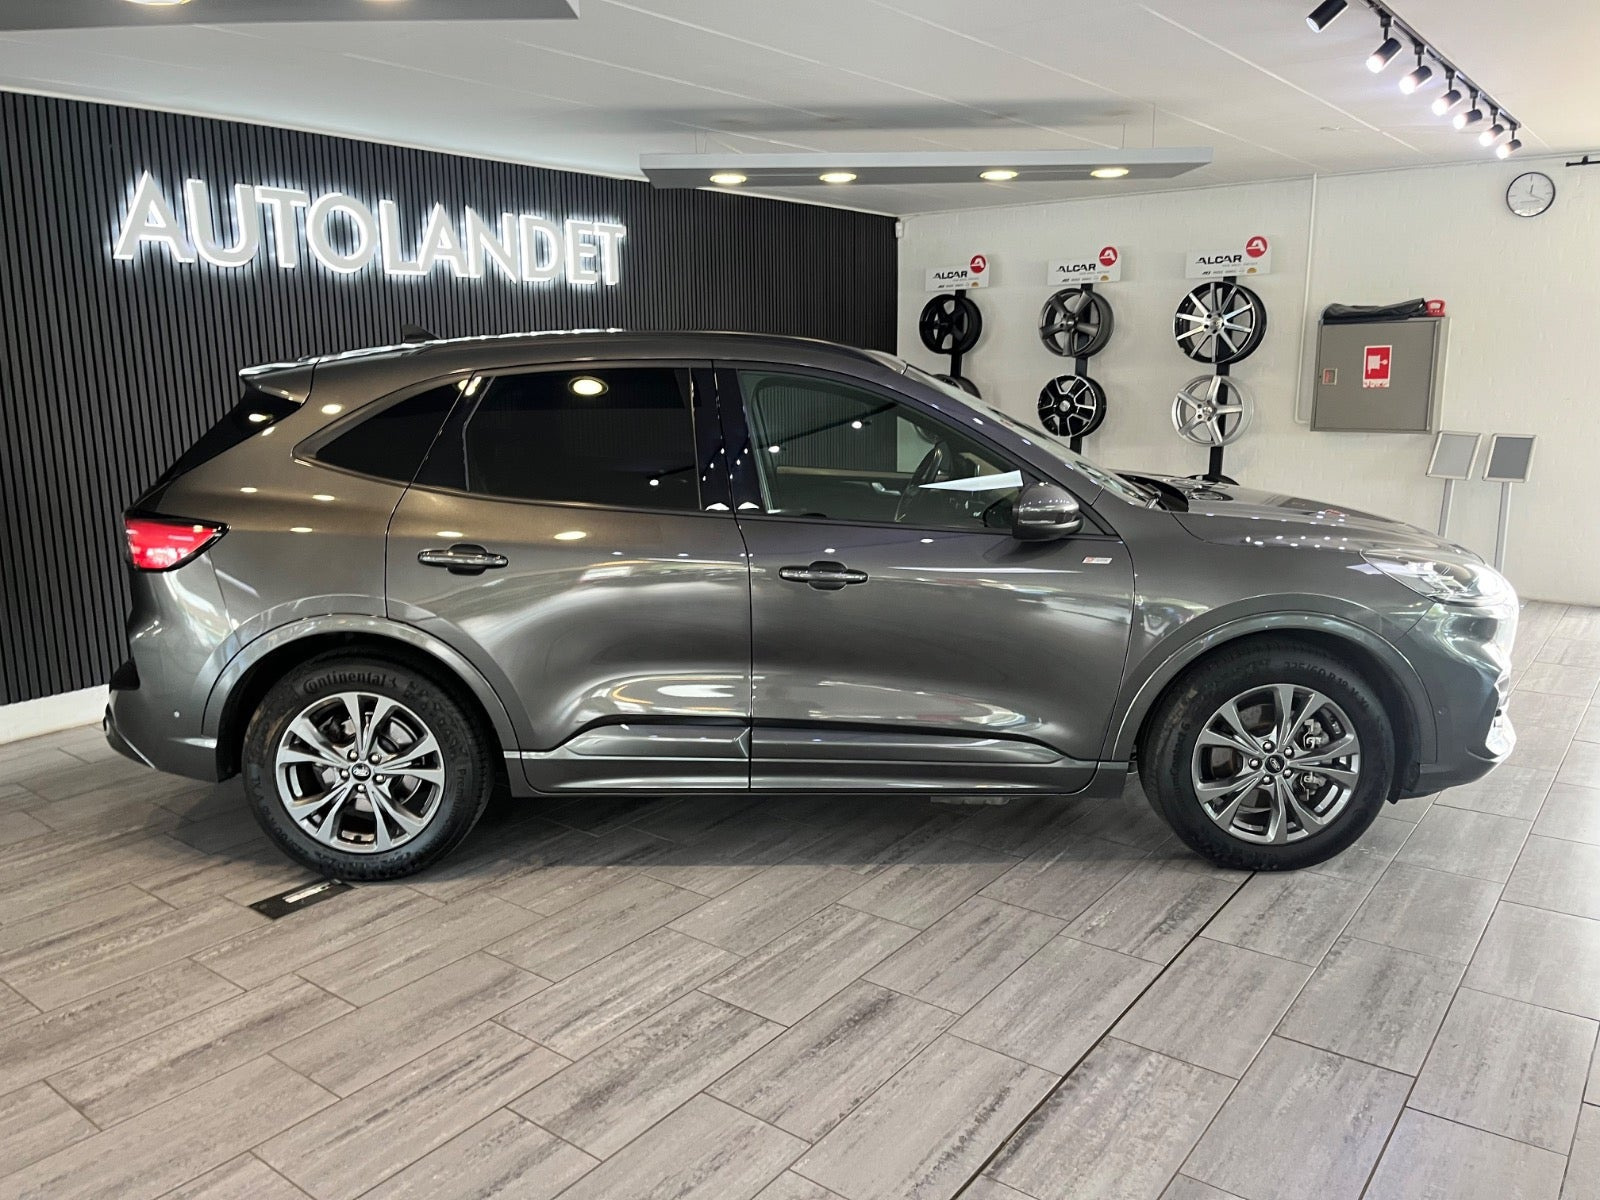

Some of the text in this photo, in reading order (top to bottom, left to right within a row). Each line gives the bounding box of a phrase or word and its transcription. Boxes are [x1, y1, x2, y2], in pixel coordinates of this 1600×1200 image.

[112, 169, 627, 286] AUTOLANDET
[1195, 254, 1243, 265] ALCAR
[1055, 263, 1097, 273] ALCAR
[932, 270, 968, 280] ALCAR
[302, 670, 388, 694] Continental
